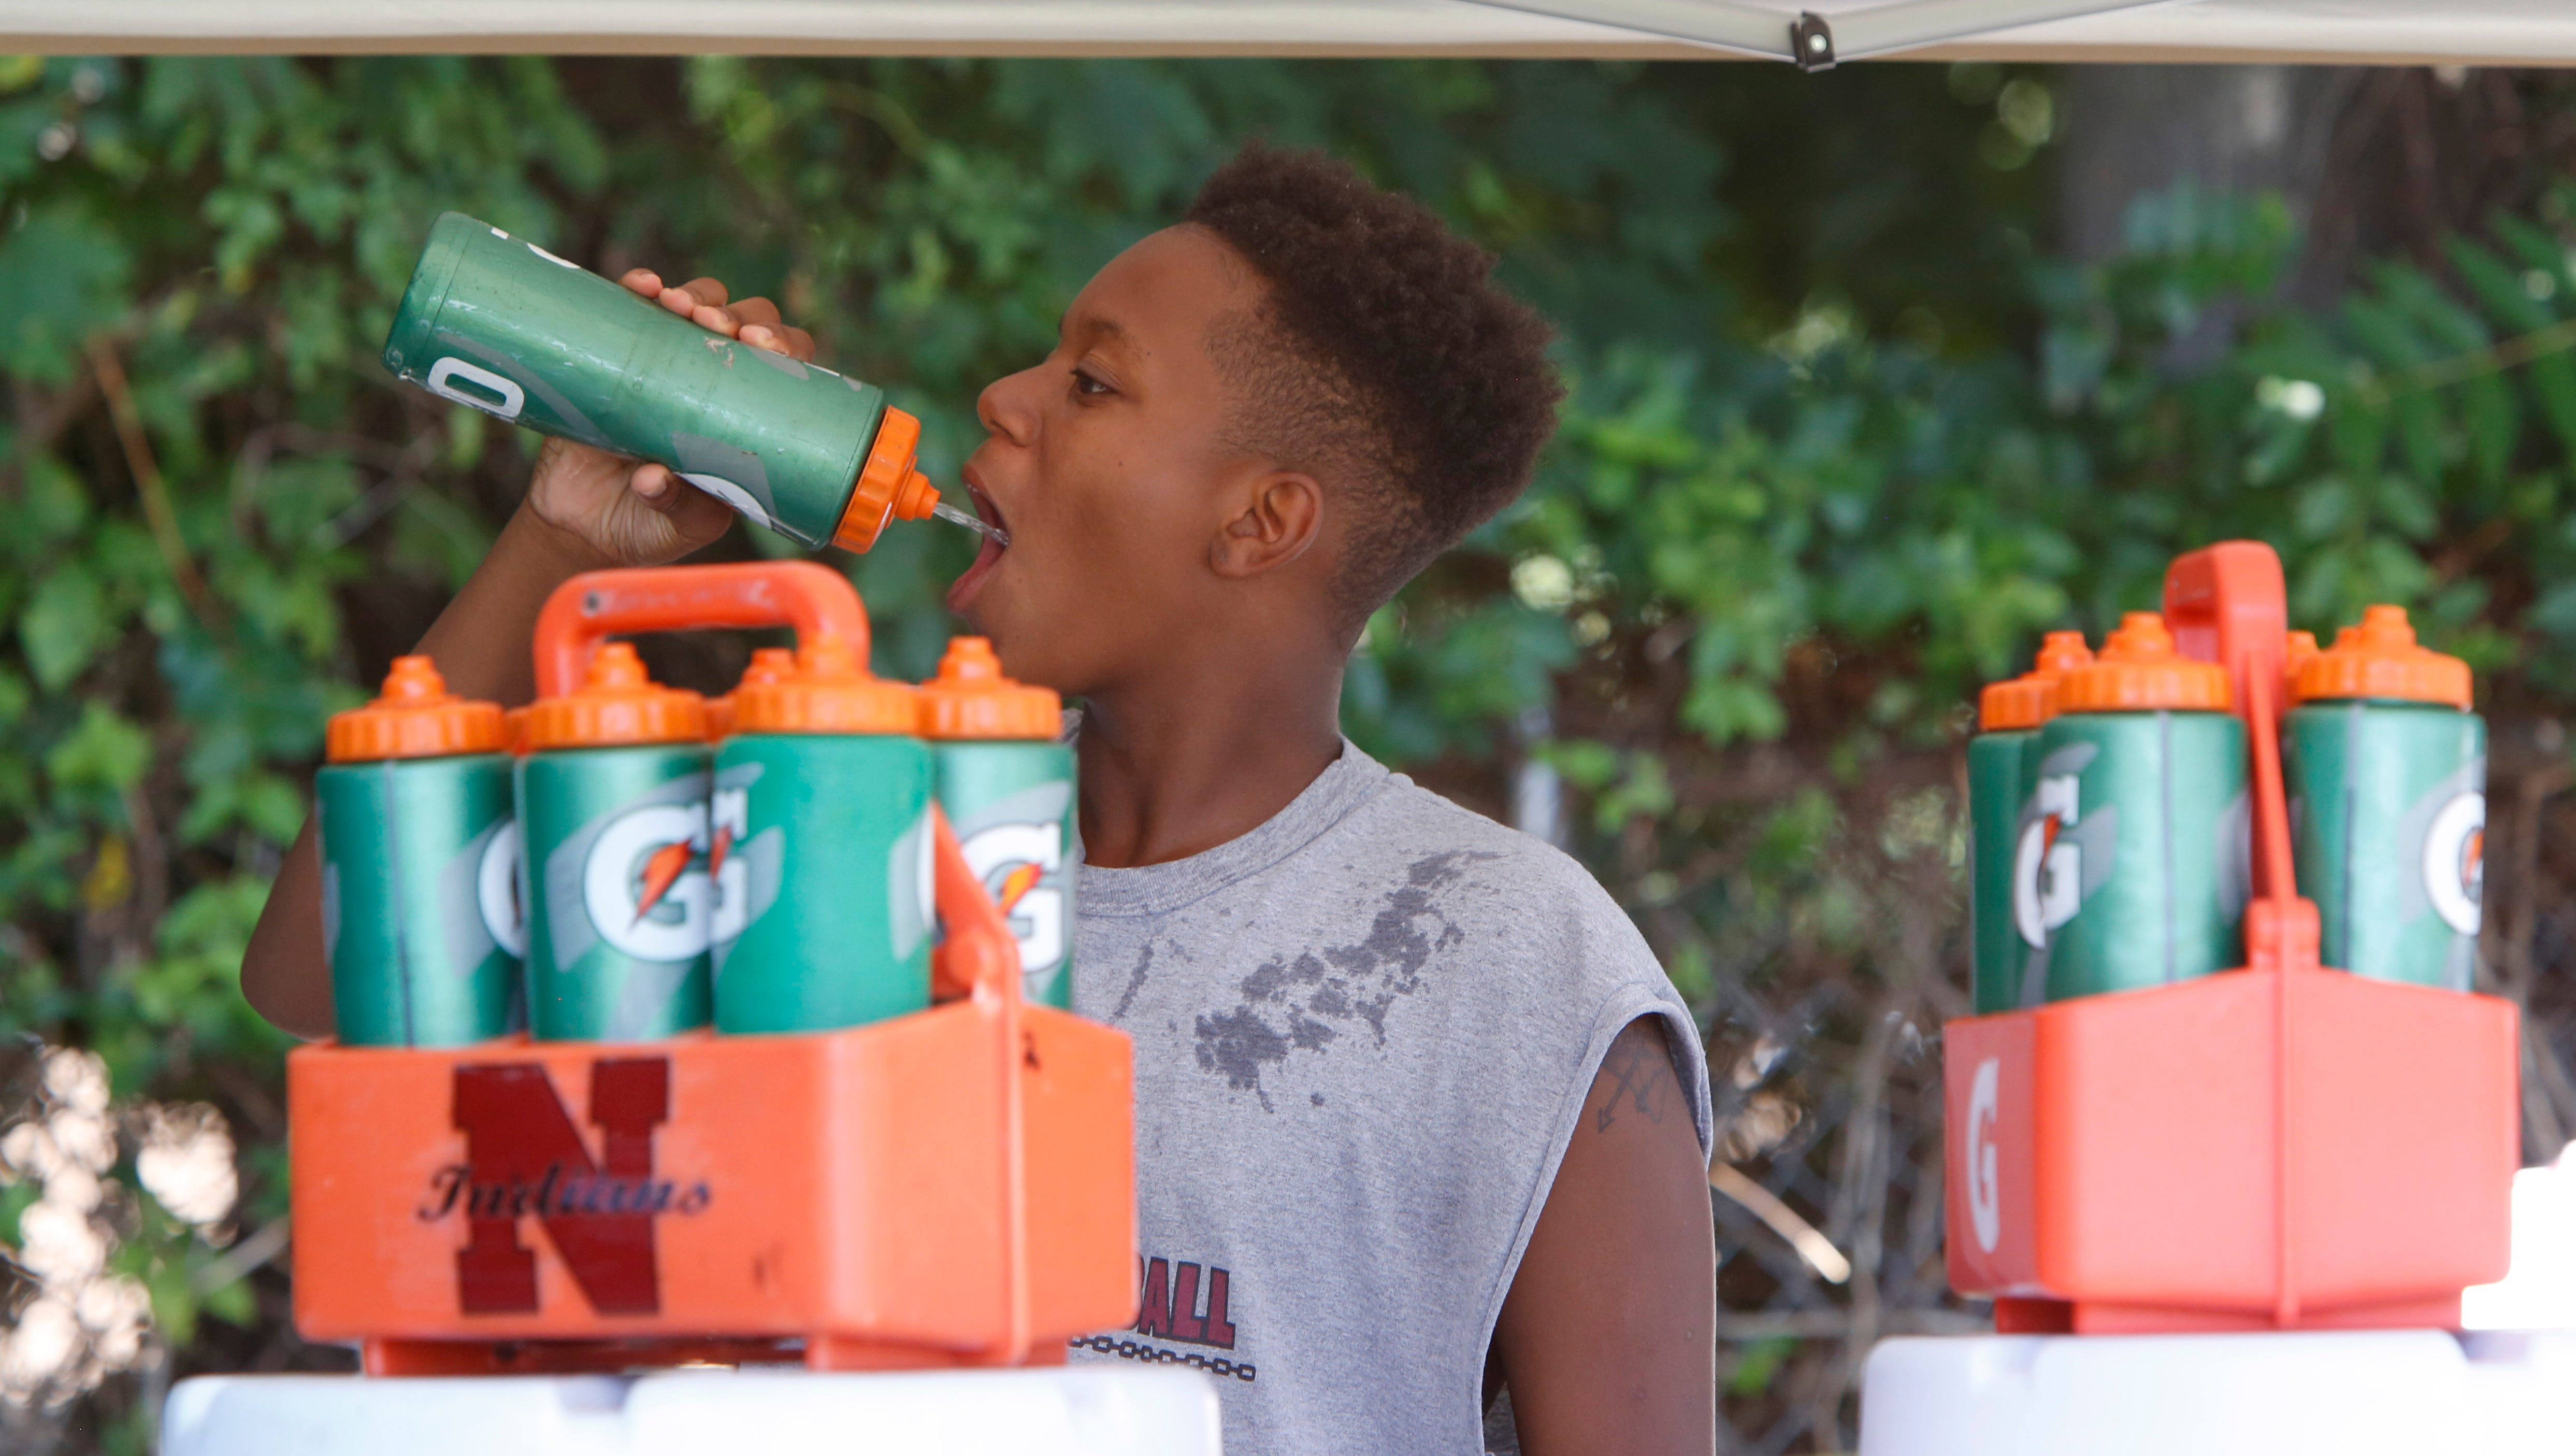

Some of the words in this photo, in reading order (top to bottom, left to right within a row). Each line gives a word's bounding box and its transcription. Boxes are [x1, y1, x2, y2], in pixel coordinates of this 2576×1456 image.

[584, 802, 712, 961] G
[960, 821, 1062, 972] G
[418, 1160, 711, 1222] Indians
[451, 1055, 672, 1318] N
[1967, 1056, 2001, 1254] G
[1133, 1254, 1236, 1350] ALL
